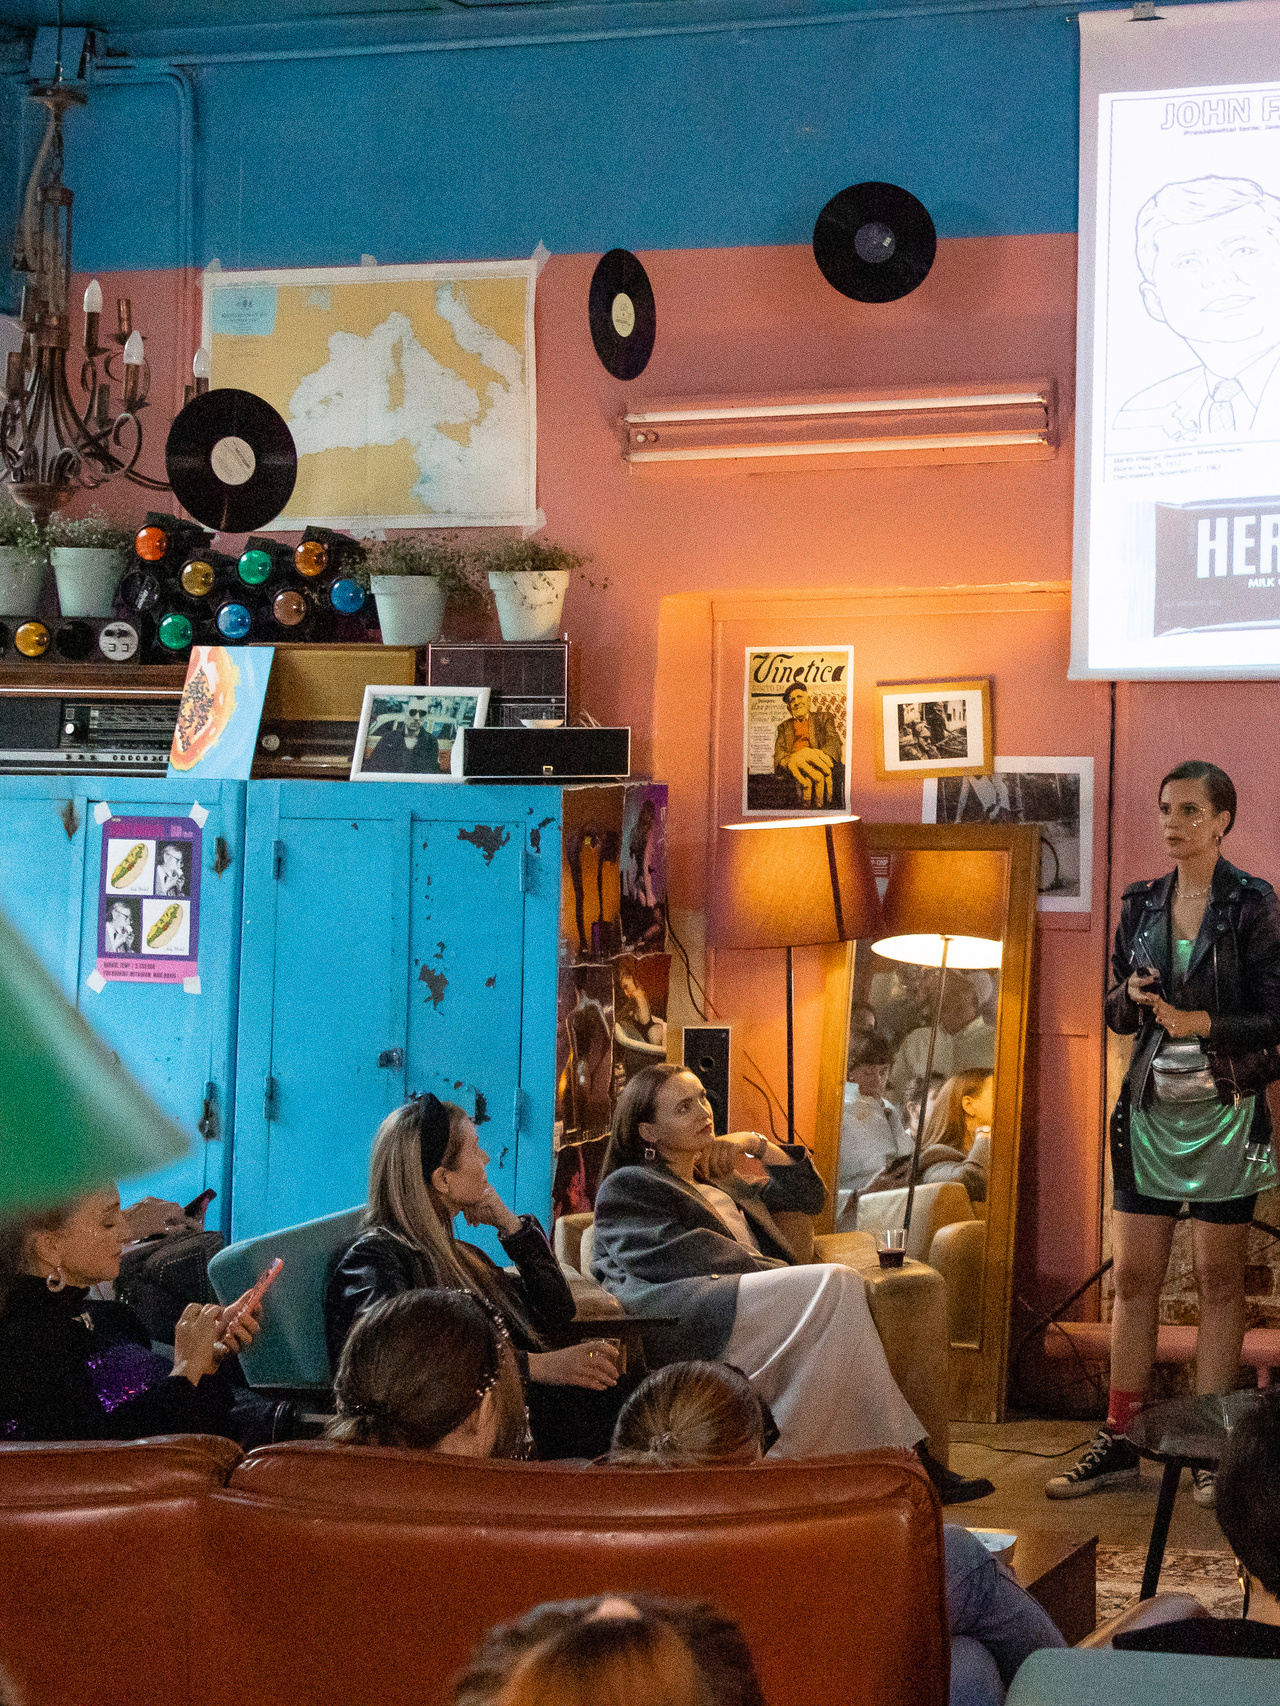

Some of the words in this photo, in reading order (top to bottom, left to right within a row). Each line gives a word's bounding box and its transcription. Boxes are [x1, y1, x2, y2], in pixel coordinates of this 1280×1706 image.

[1160, 97, 1251, 130] JOHN
[1248, 576, 1274, 588] MILK
[753, 653, 846, 684] Vinetica
